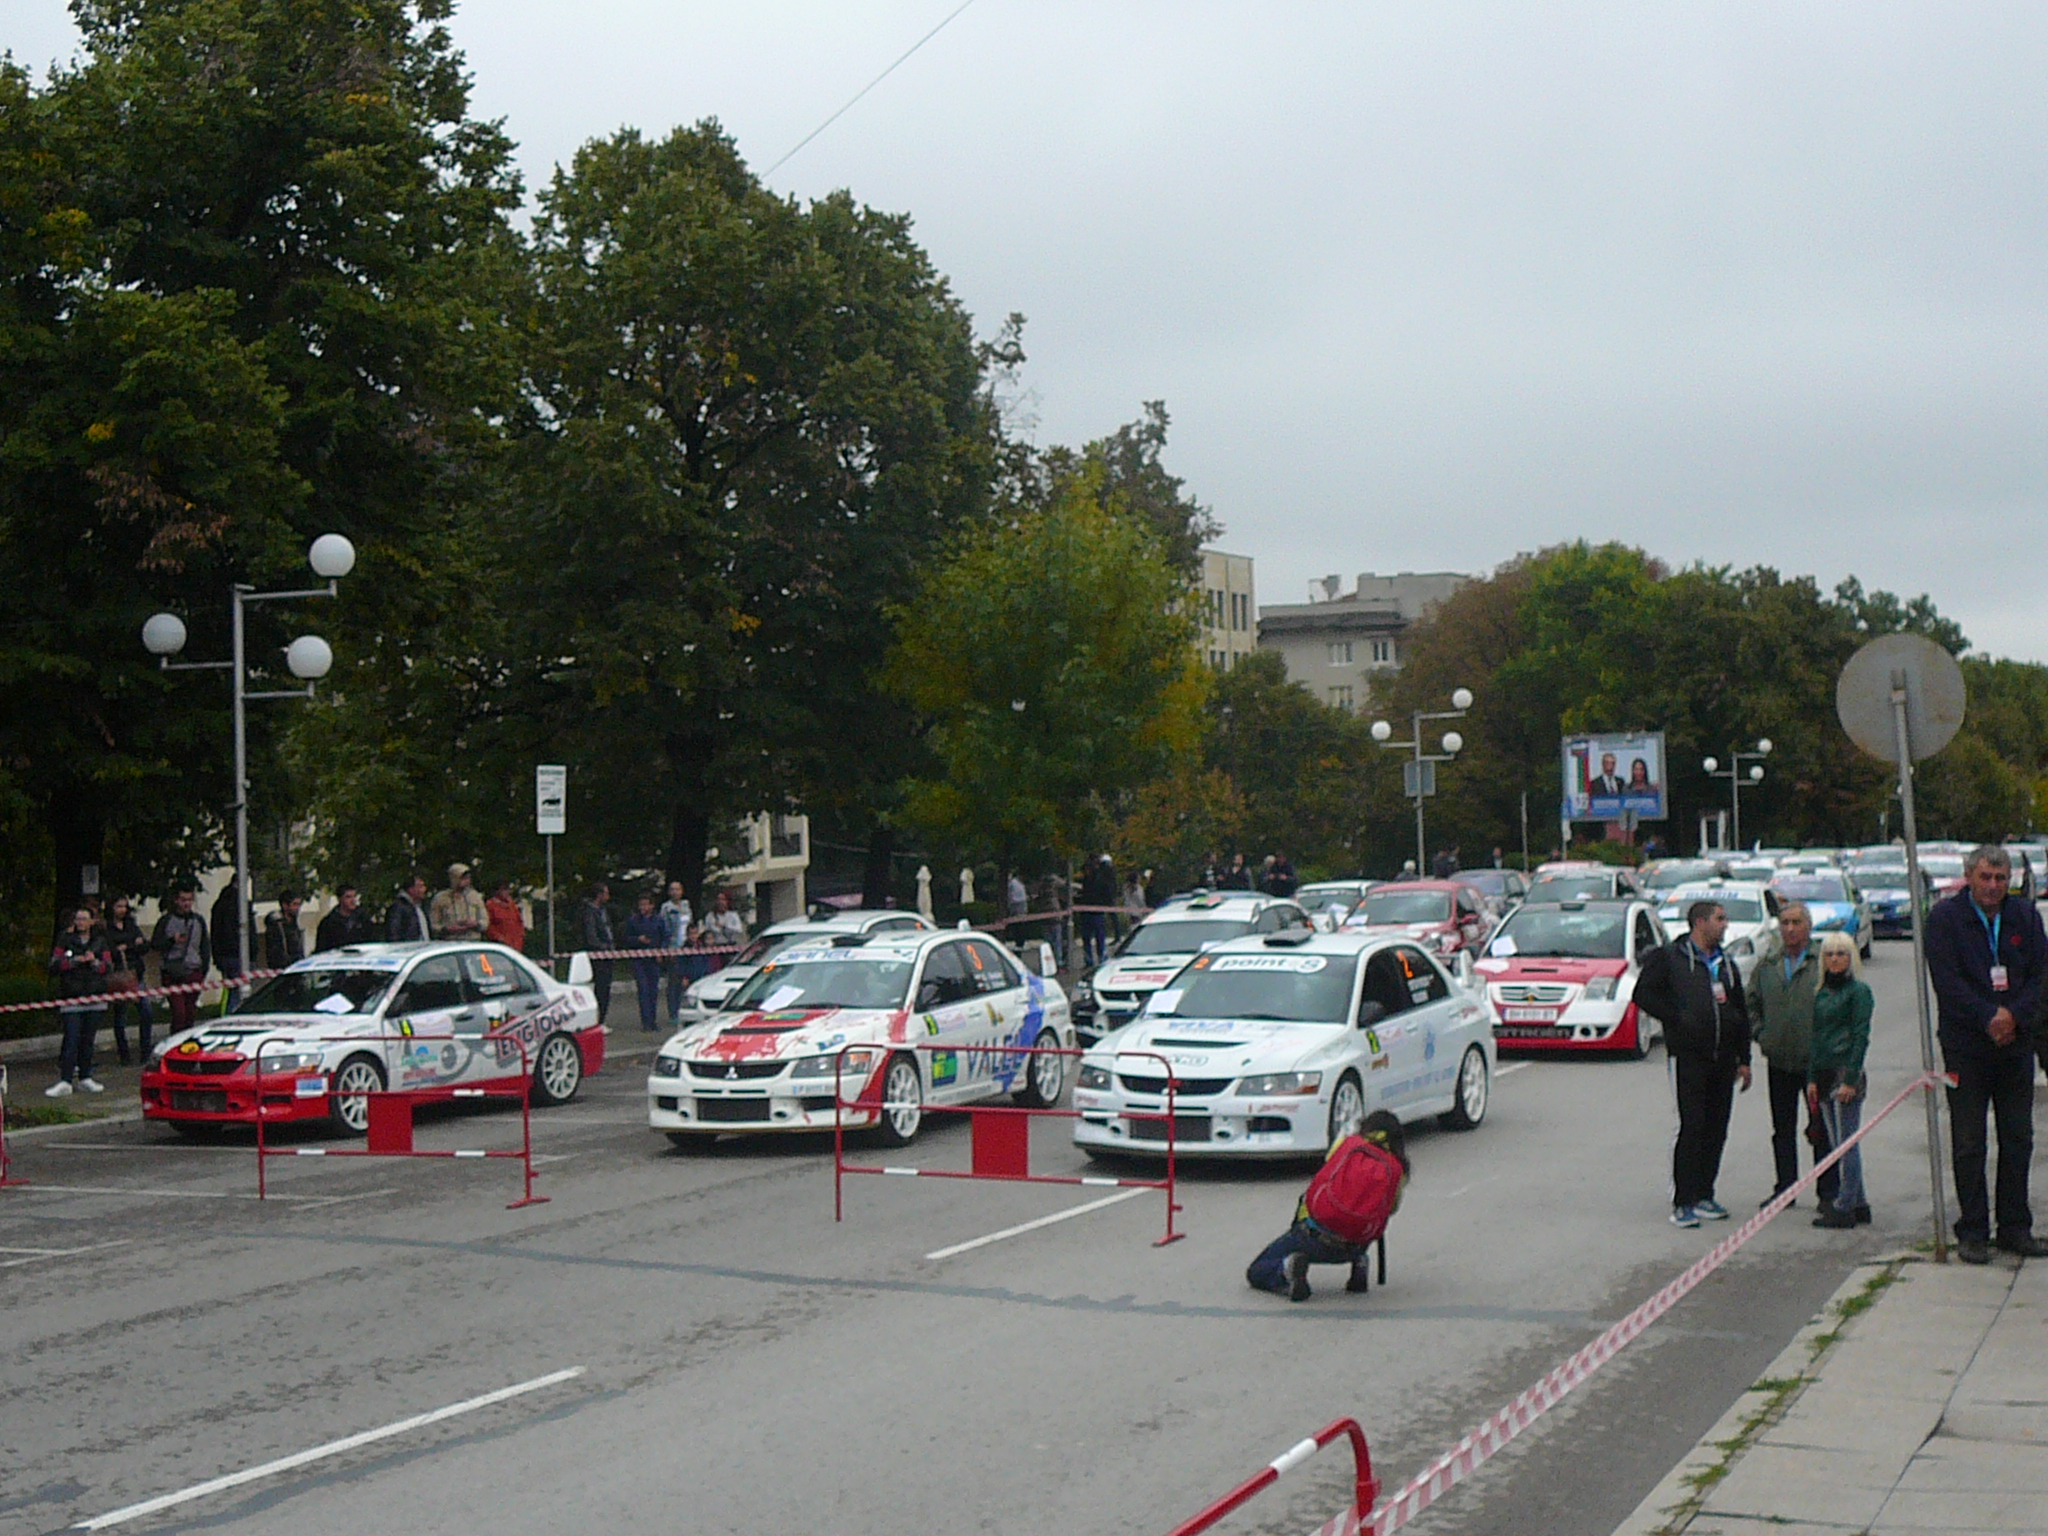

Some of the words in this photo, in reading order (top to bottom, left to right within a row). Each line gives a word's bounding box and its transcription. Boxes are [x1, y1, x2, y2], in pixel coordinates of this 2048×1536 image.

[480, 953, 494, 977] 4
[966, 944, 983, 970] 3
[1194, 957, 1209, 969] 2
[1220, 958, 1288, 969] point
[1299, 958, 1321, 969] S
[1397, 951, 1414, 978] 2
